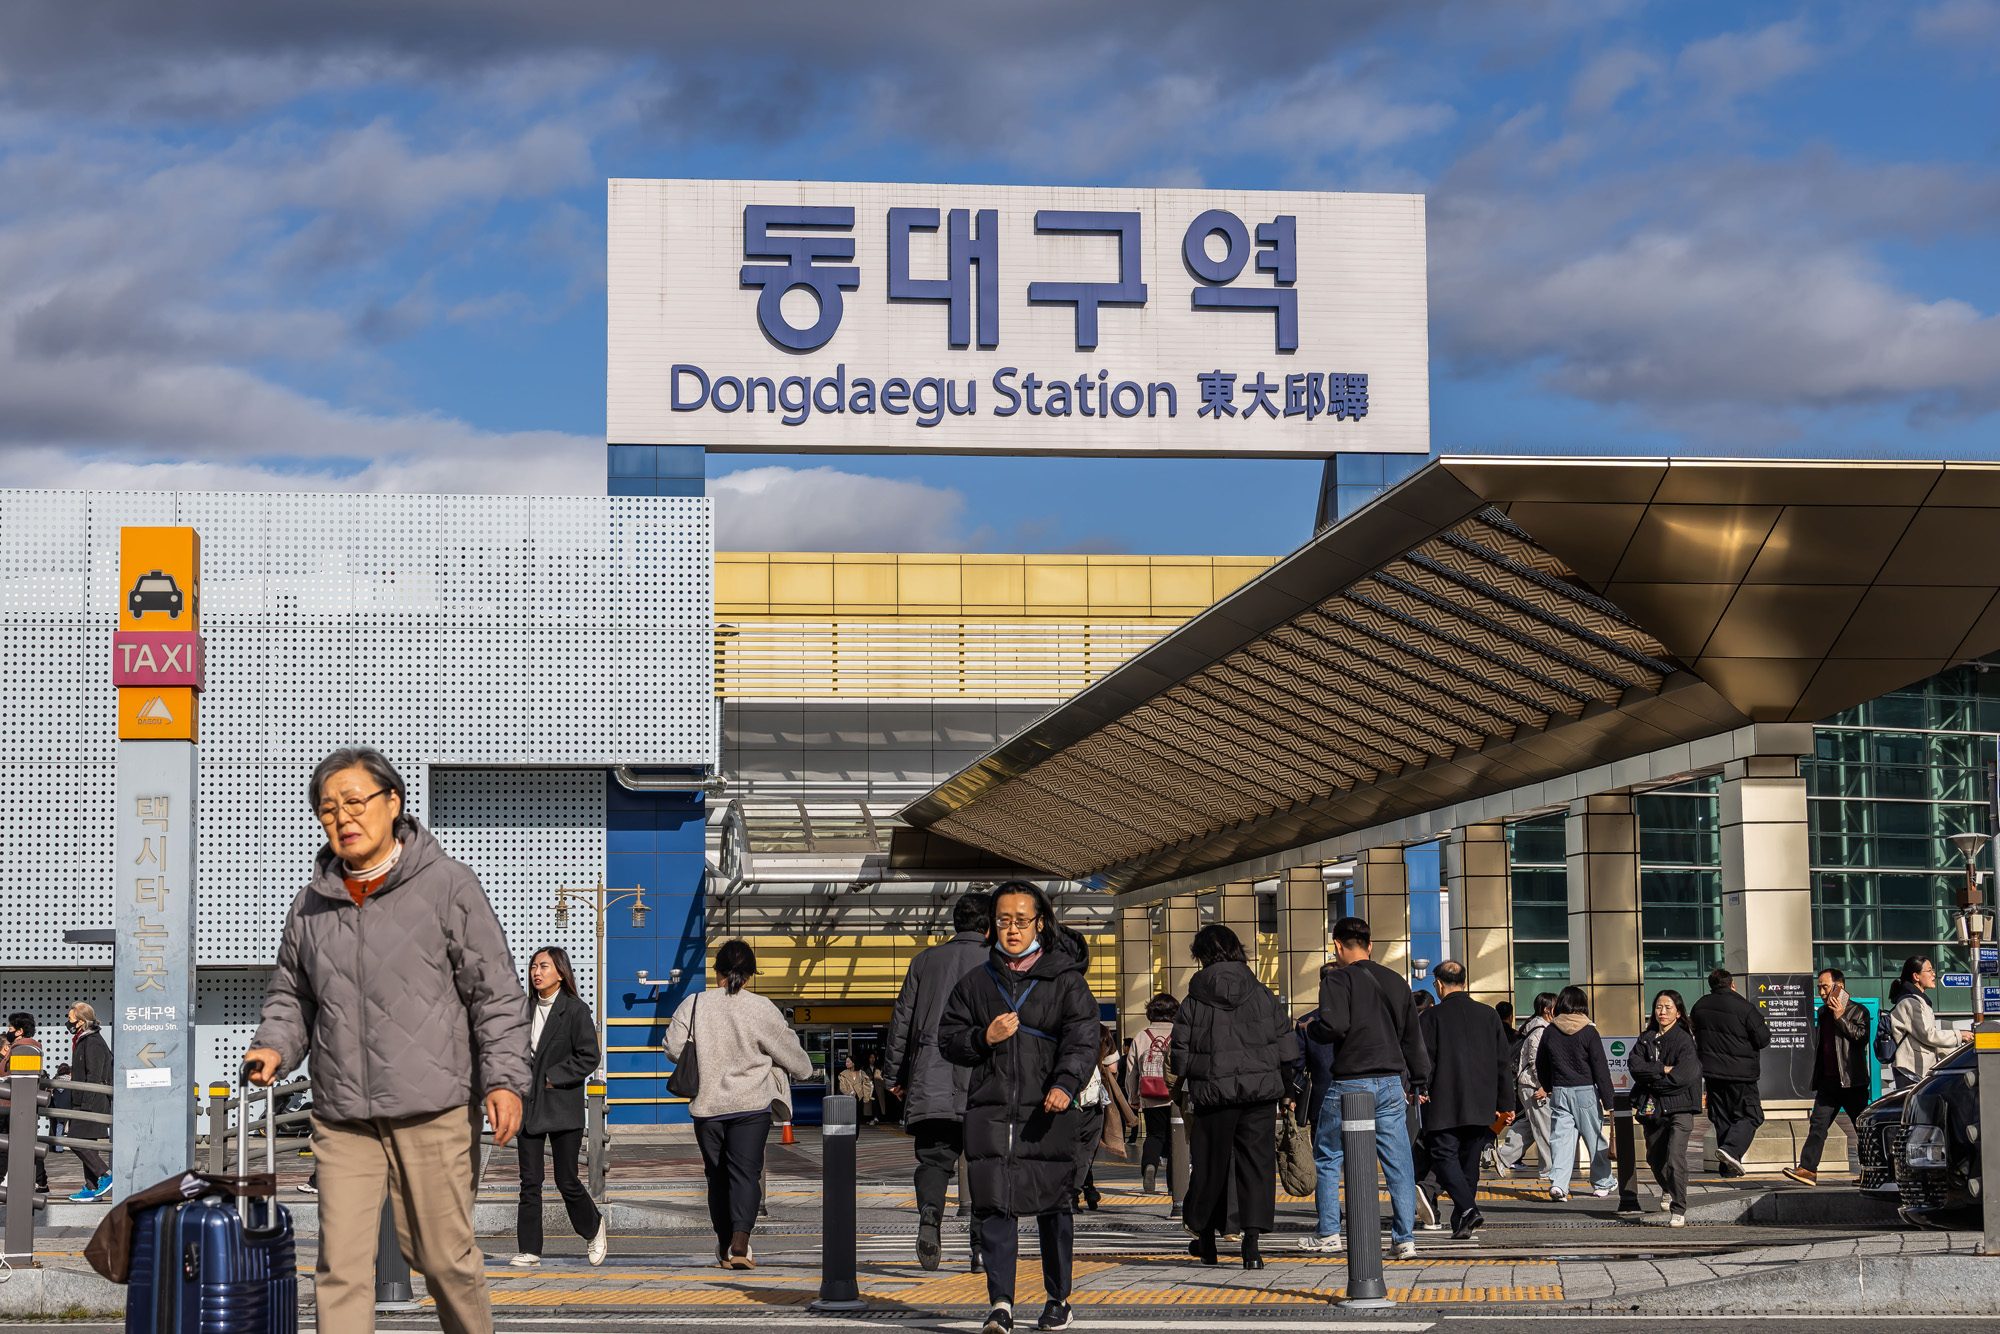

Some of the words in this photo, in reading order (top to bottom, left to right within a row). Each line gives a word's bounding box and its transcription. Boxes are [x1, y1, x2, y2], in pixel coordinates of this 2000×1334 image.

[740, 204, 1299, 351] 동대구역
[671, 364, 977, 426] Dongdaegu
[993, 368, 1177, 417] Station
[1197, 370, 1369, 421] 東大邱驛
[117, 643, 193, 674] TAXI
[124, 1005, 177, 1021] 동대구역
[803, 1008, 811, 1021] 3
[122, 1023, 164, 1032] Dongdaegu
[165, 1022, 179, 1031] Stn.
